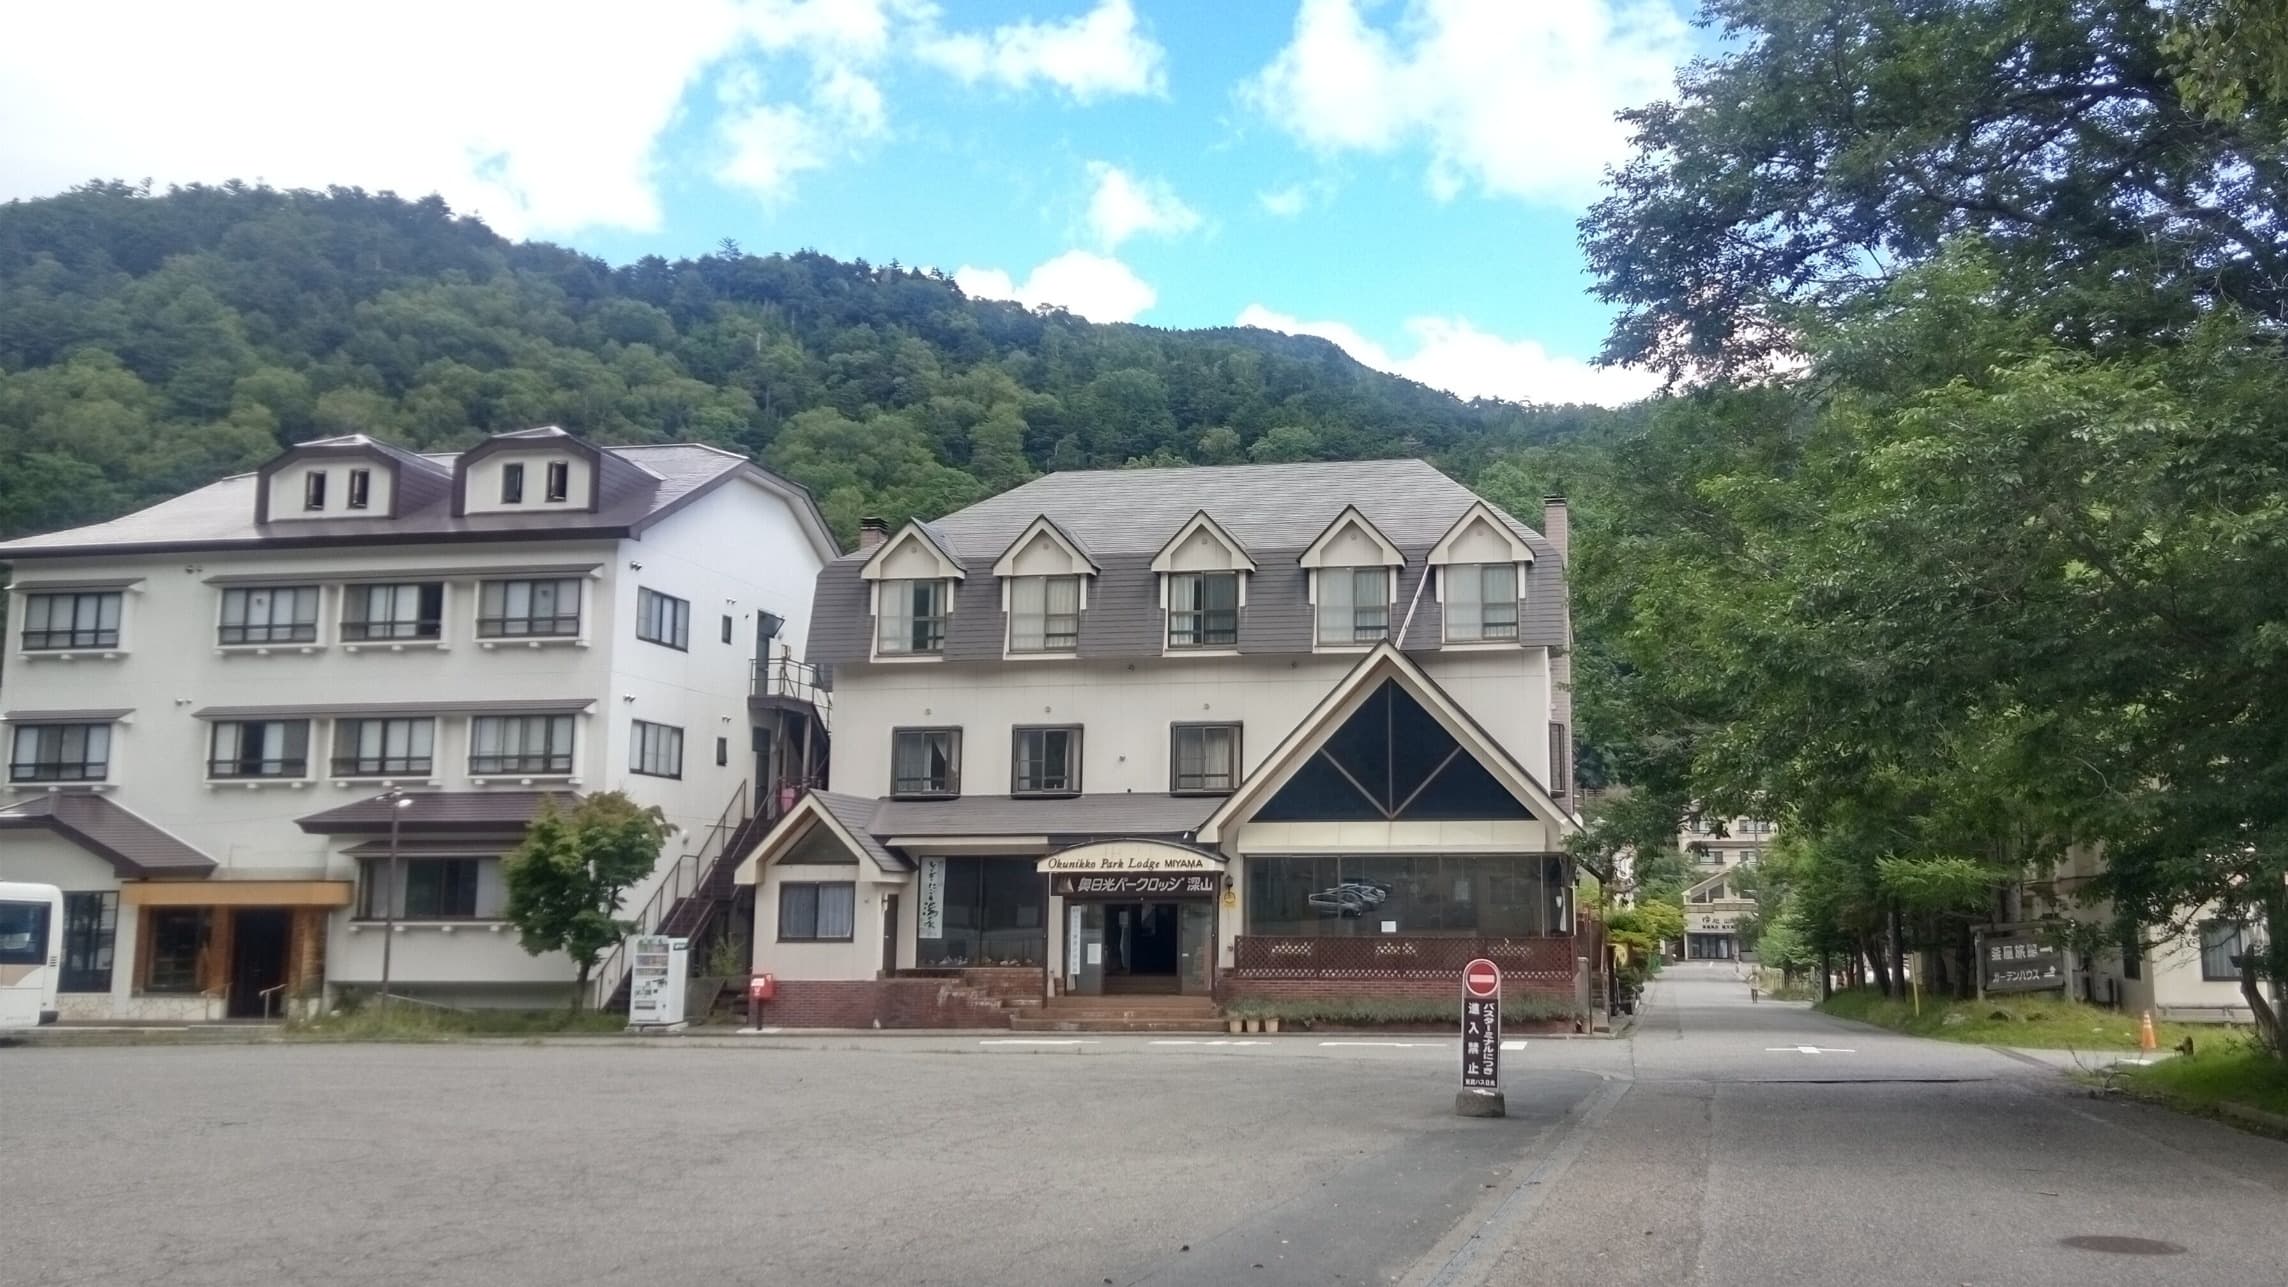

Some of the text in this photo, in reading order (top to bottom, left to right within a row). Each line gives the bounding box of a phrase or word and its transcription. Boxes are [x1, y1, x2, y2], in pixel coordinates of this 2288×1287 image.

[1048, 858, 1204, 871] Okunikko Park Lodge MIYAMA
[1187, 876, 1213, 892] 深山
[1483, 1003, 1496, 1076] バスターミナルにつき
